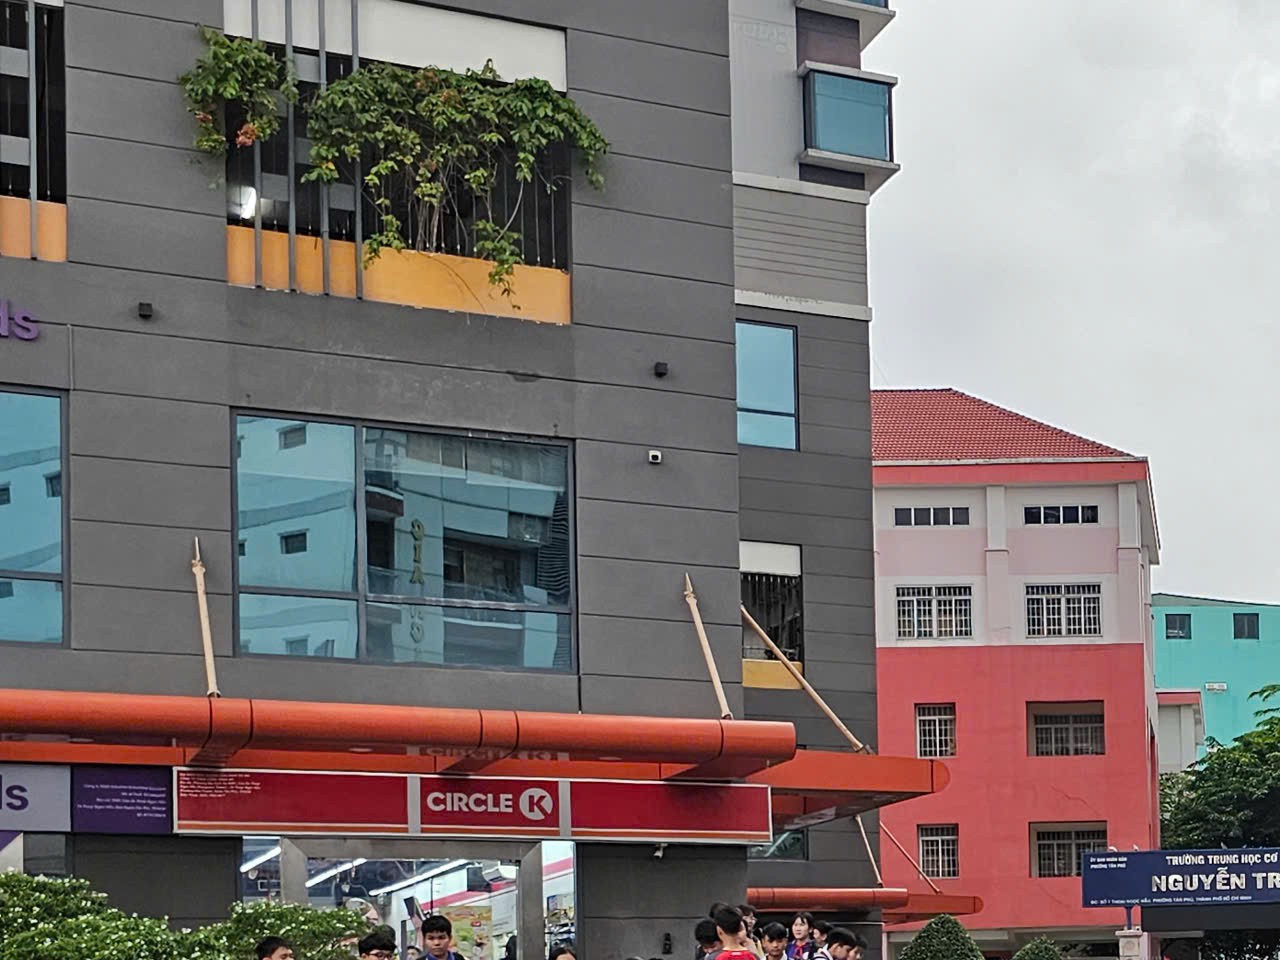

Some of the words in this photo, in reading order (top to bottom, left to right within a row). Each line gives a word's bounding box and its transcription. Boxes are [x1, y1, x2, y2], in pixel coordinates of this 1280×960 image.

[427, 792, 513, 813] CIRCLE
[523, 790, 552, 819] K
[1166, 853, 1205, 865] TRƯỜNG
[1207, 854, 1239, 865] TRUNG
[1241, 853, 1262, 866] HỌC
[1264, 852, 1279, 863] CƠ
[1151, 866, 1246, 892] NGUYỄN
